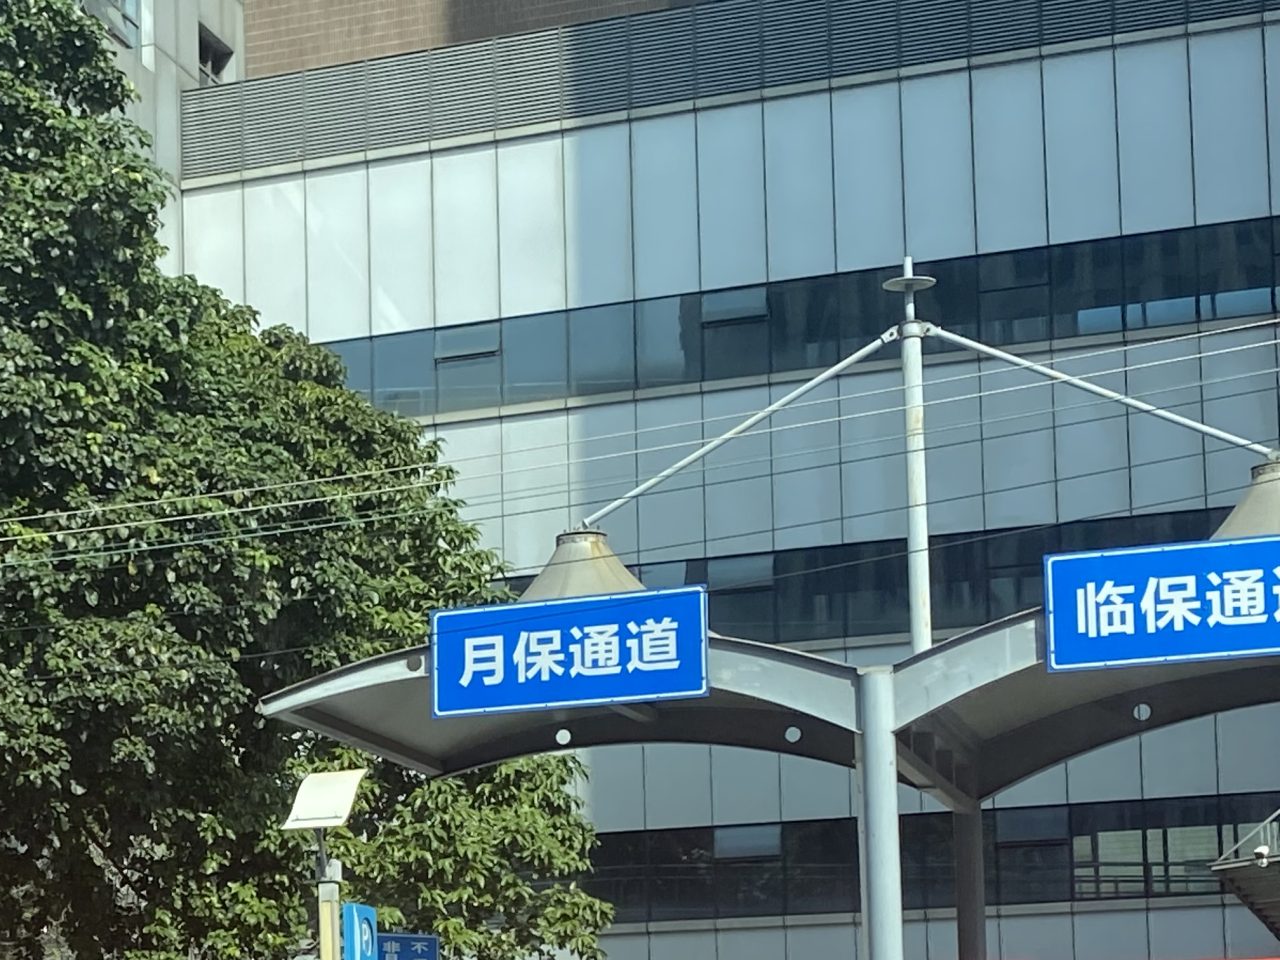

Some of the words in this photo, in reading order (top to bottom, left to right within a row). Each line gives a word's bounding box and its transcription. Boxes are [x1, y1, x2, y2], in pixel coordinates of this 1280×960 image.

[1076, 566, 1280, 638] 临保通
[458, 617, 681, 688] 月保通道
